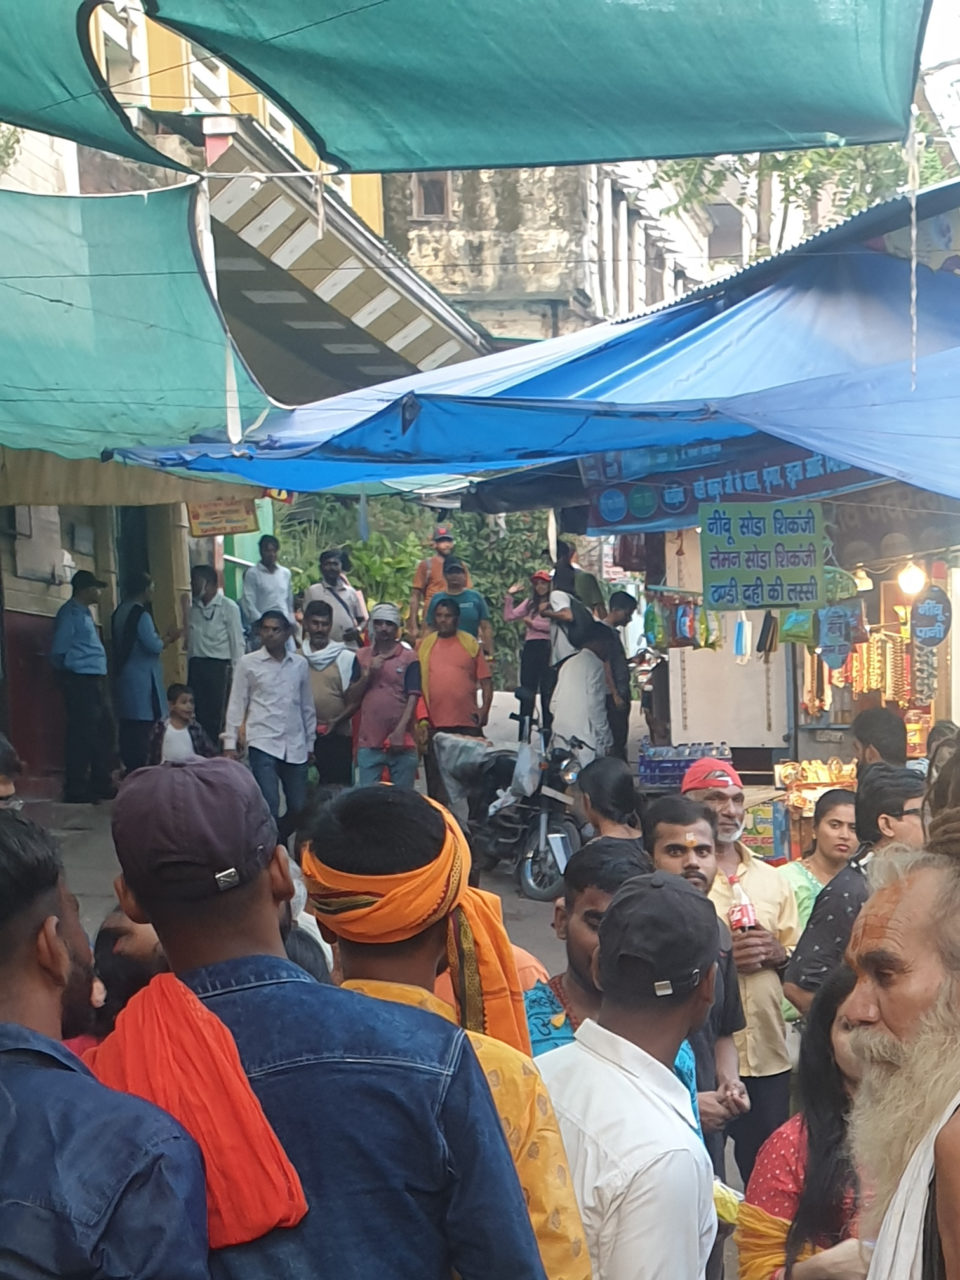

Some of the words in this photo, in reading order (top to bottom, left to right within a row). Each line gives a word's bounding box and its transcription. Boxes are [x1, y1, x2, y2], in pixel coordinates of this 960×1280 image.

[773, 509, 815, 536] शिकंजी
[709, 545, 741, 569] लेमन
[774, 543, 816, 569] शिकंजी
[742, 577, 763, 603] दही
[767, 576, 783, 601] की
[787, 575, 818, 602] लस्सी
[915, 622, 944, 642] पानी
